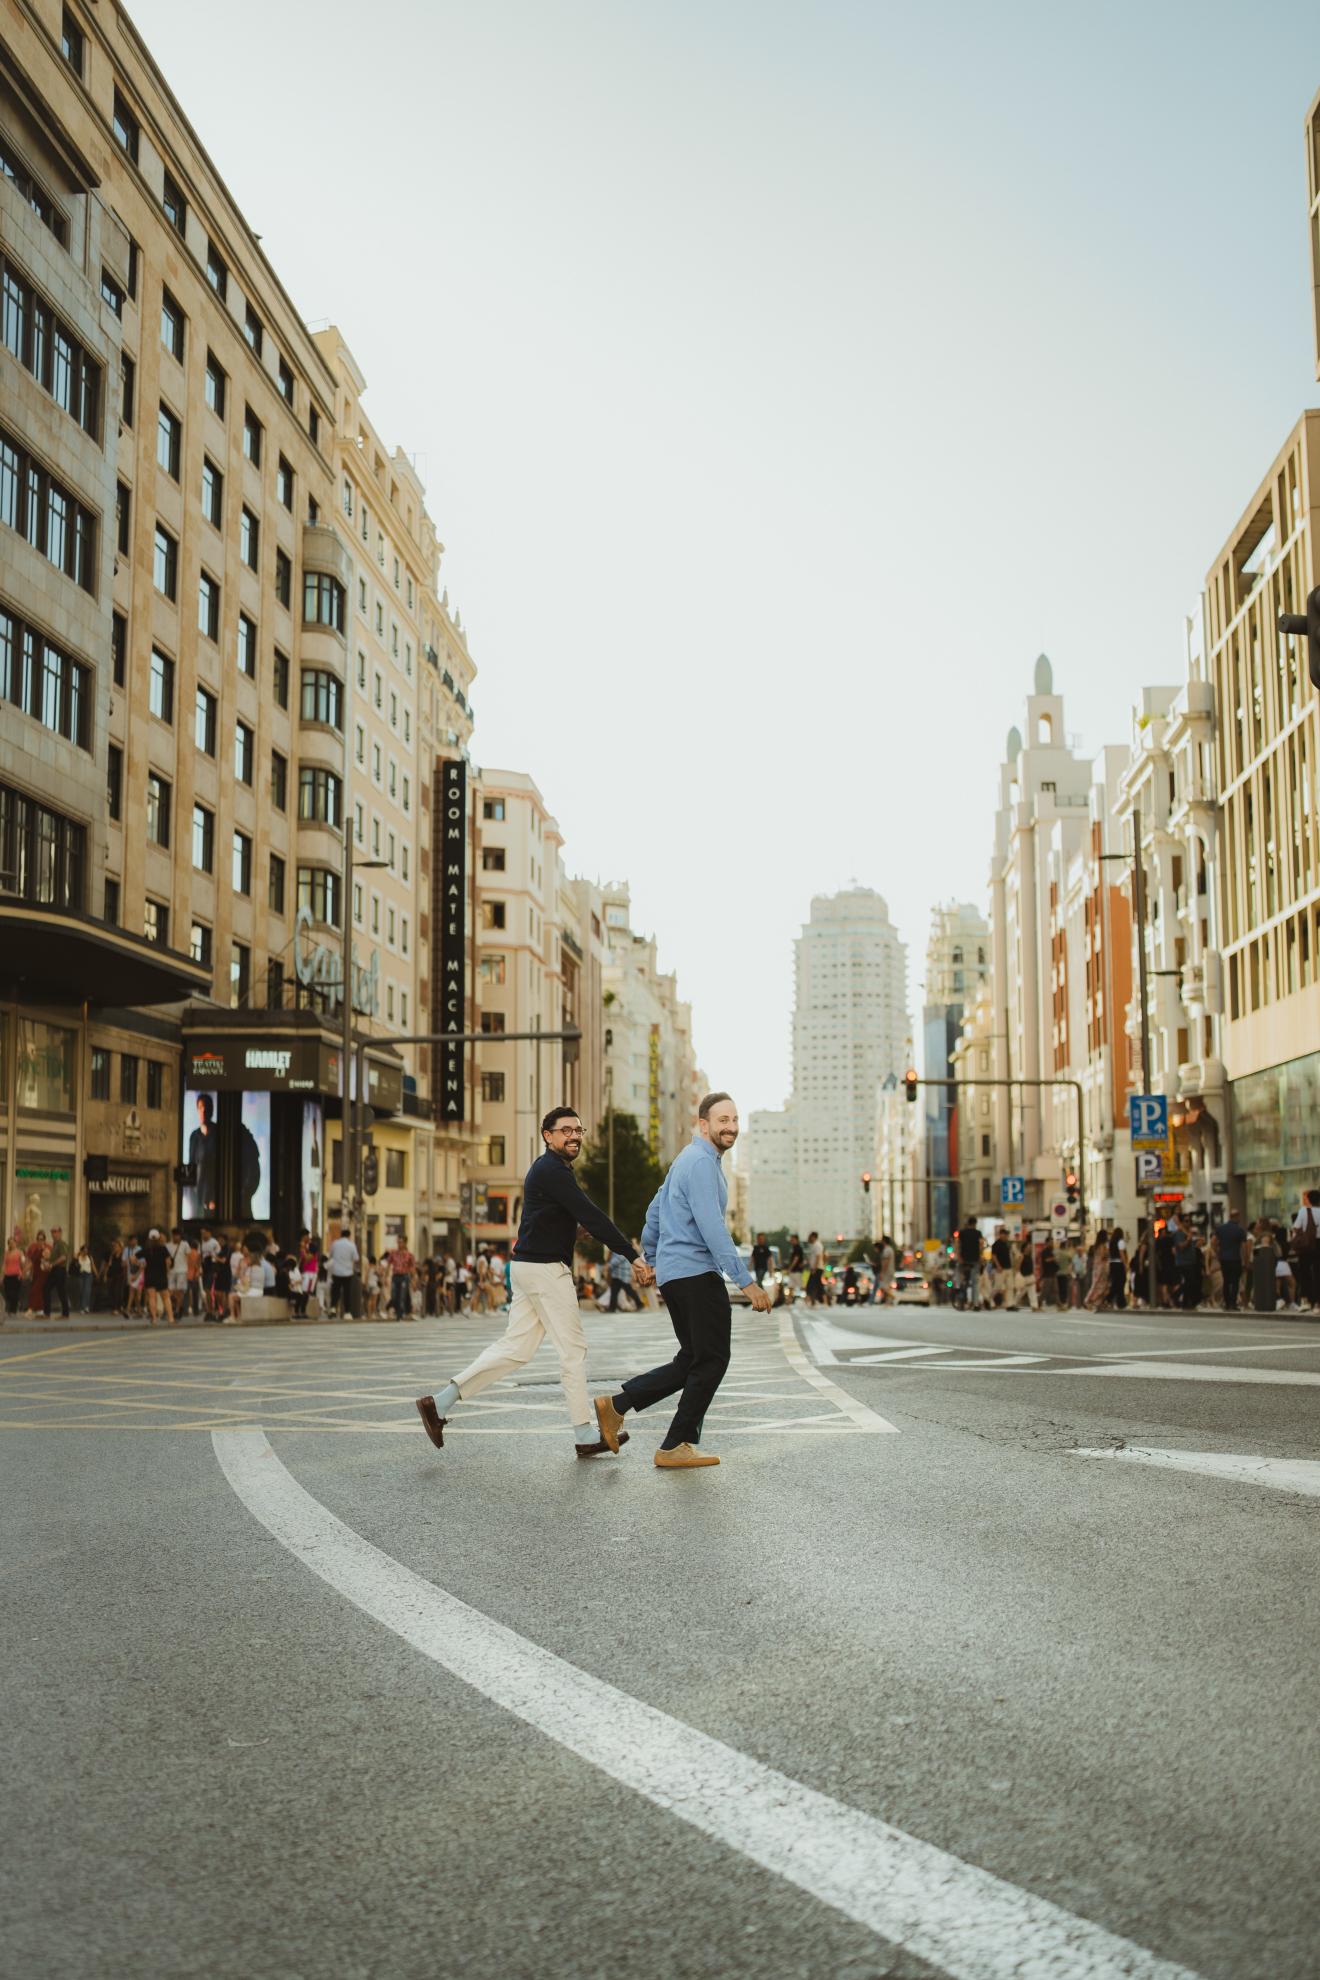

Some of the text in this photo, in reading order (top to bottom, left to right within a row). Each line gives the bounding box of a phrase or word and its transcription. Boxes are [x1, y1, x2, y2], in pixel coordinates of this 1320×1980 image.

[446, 768, 460, 1112] ROOM MATE MACARENA
[294, 905, 381, 1016] Captol
[245, 1050, 292, 1068] HAMLET
[1137, 1100, 1162, 1135] P
[1138, 1154, 1158, 1178] P
[1007, 1180, 1021, 1201] P
